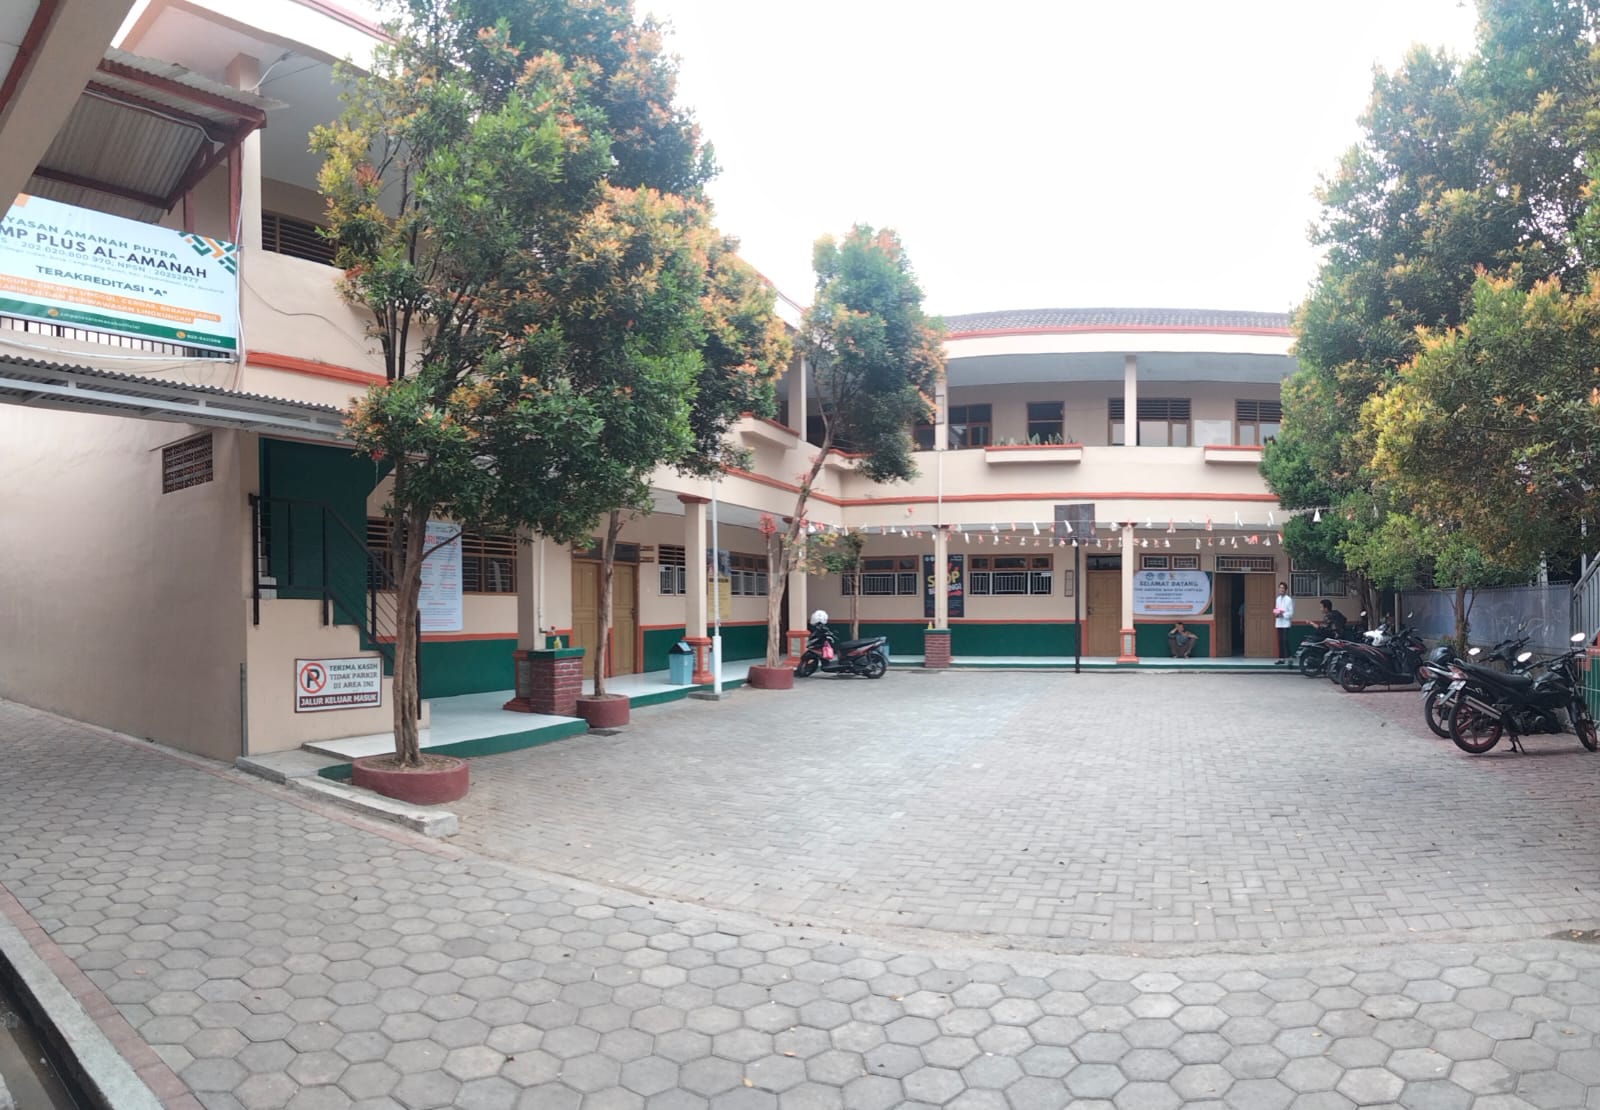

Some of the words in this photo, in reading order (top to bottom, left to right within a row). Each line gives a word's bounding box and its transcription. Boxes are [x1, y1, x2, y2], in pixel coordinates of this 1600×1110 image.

[64, 229, 128, 249] AMANAH
[134, 244, 177, 260] PUTRA
[36, 232, 86, 252] PLUS
[94, 246, 206, 278] AL-AMANAH
[35, 265, 145, 293] TERAKREDITASI
[329, 664, 356, 672] TERIMA
[329, 673, 350, 681] TIDAK
[352, 671, 378, 679] PARKIR
[362, 680, 374, 688] INI
[300, 697, 324, 706] JALUR
[324, 695, 353, 705] KELUAR
[353, 693, 377, 703] MASUK
